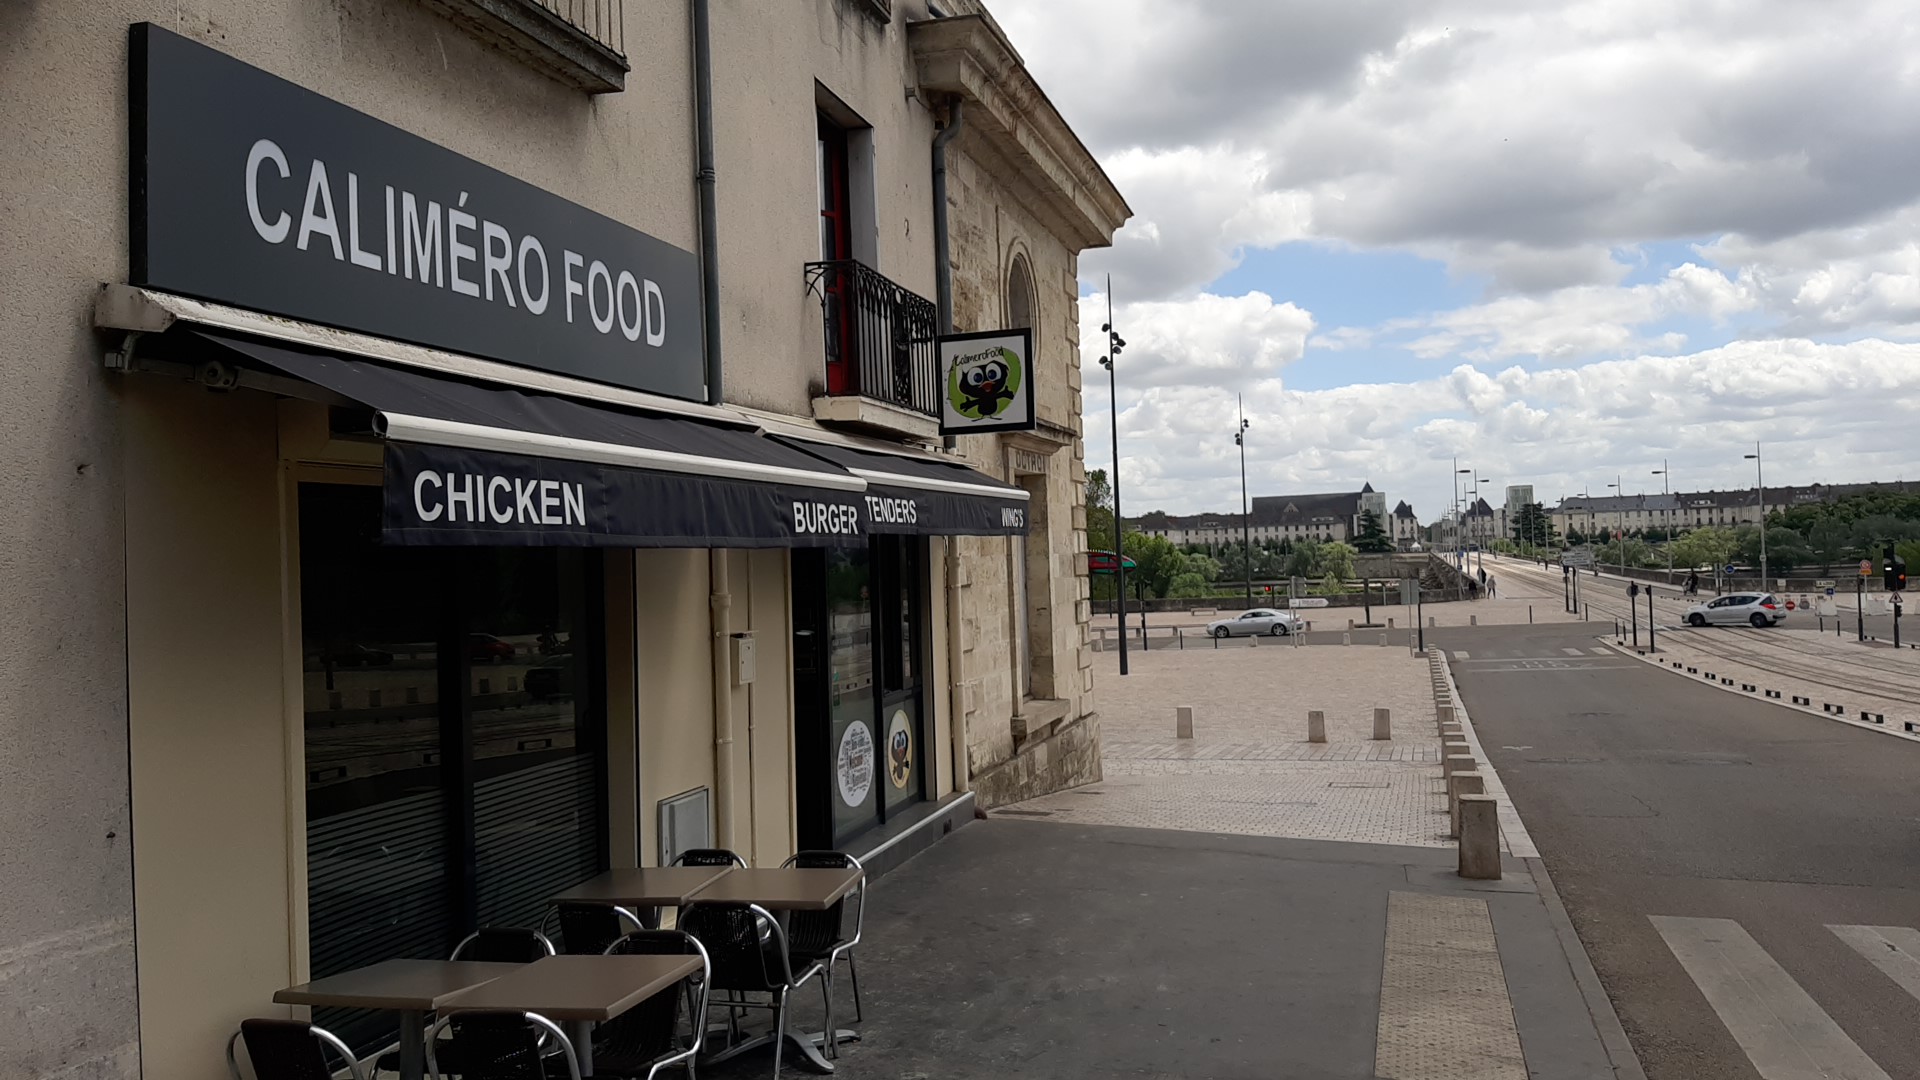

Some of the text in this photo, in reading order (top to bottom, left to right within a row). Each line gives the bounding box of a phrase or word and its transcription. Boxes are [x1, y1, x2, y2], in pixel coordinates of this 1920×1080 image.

[245, 139, 666, 348] CALIMÉRO FOOD
[413, 470, 860, 535] CHICKEN BURGER
[864, 495, 917, 524] TENDERS
